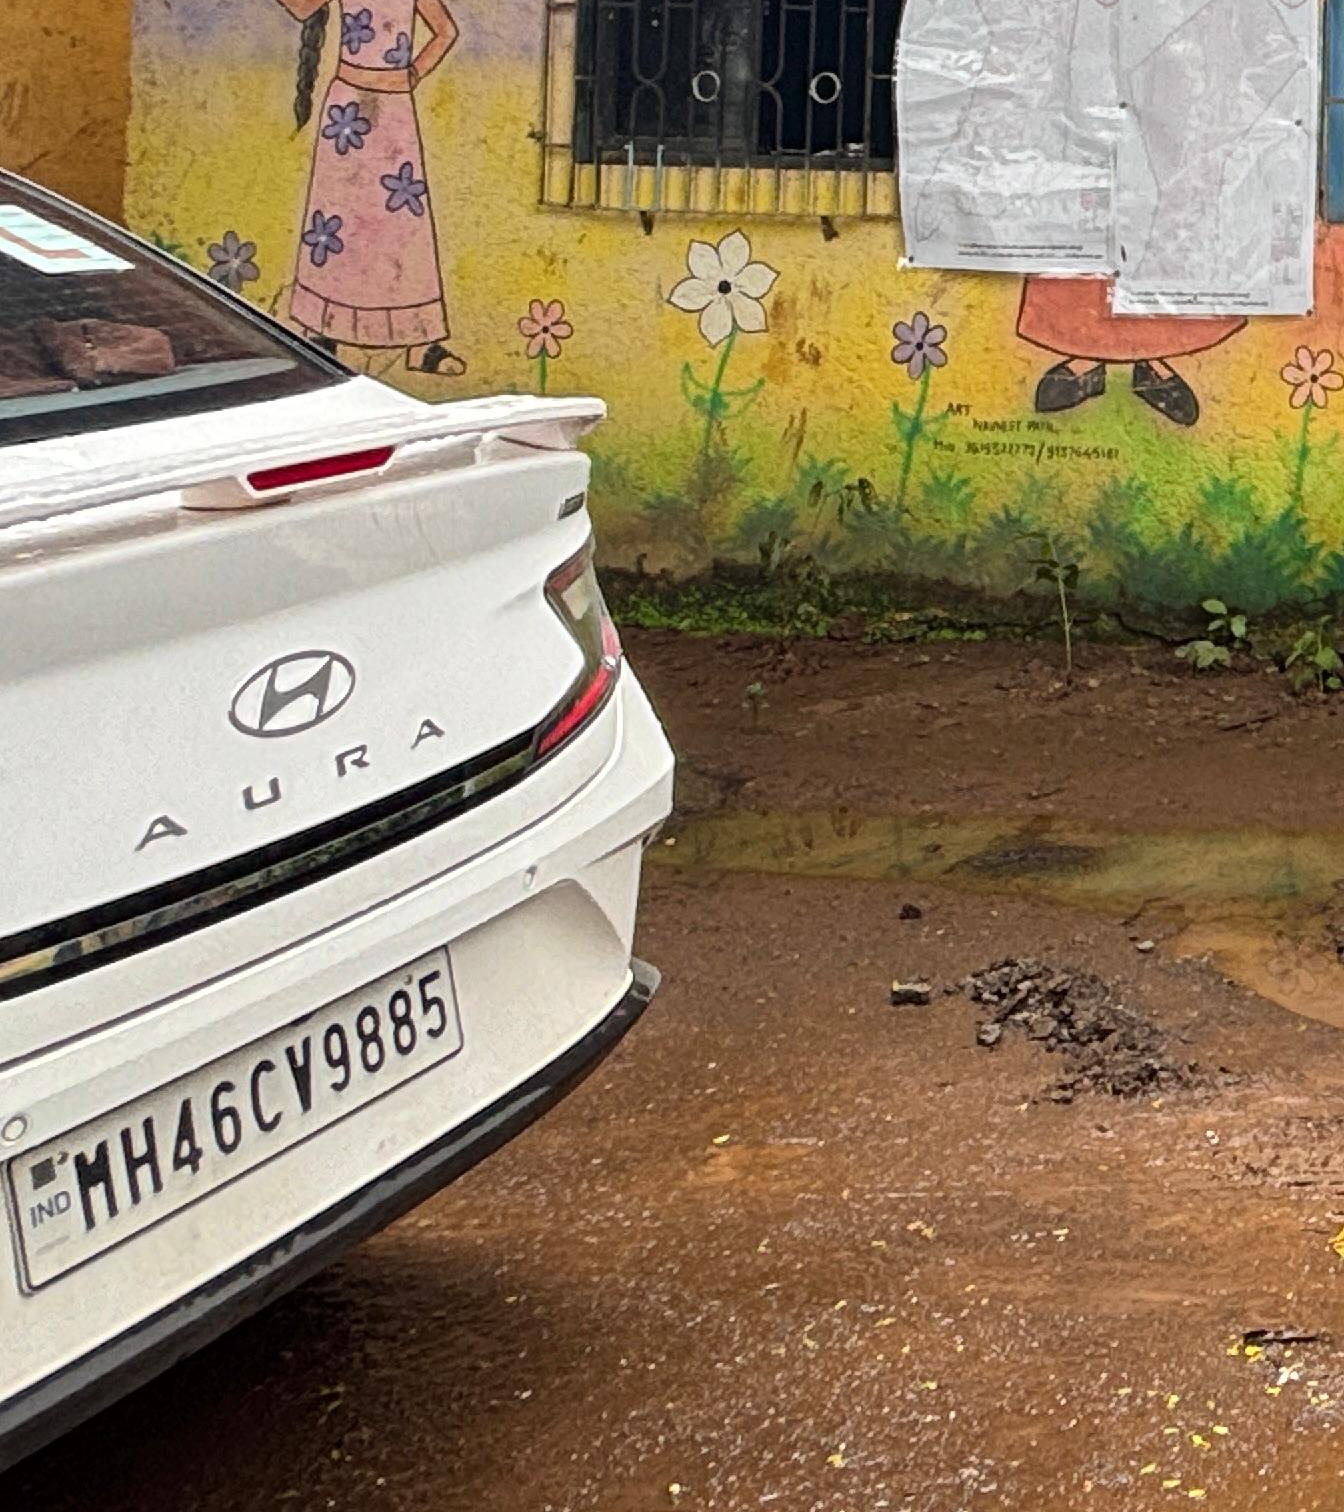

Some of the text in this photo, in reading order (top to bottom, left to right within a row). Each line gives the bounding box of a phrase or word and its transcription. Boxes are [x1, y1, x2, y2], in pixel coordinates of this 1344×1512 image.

[135, 718, 445, 852] AURA
[74, 969, 450, 1232] MH46CV9885
[30, 1190, 72, 1229] IND
